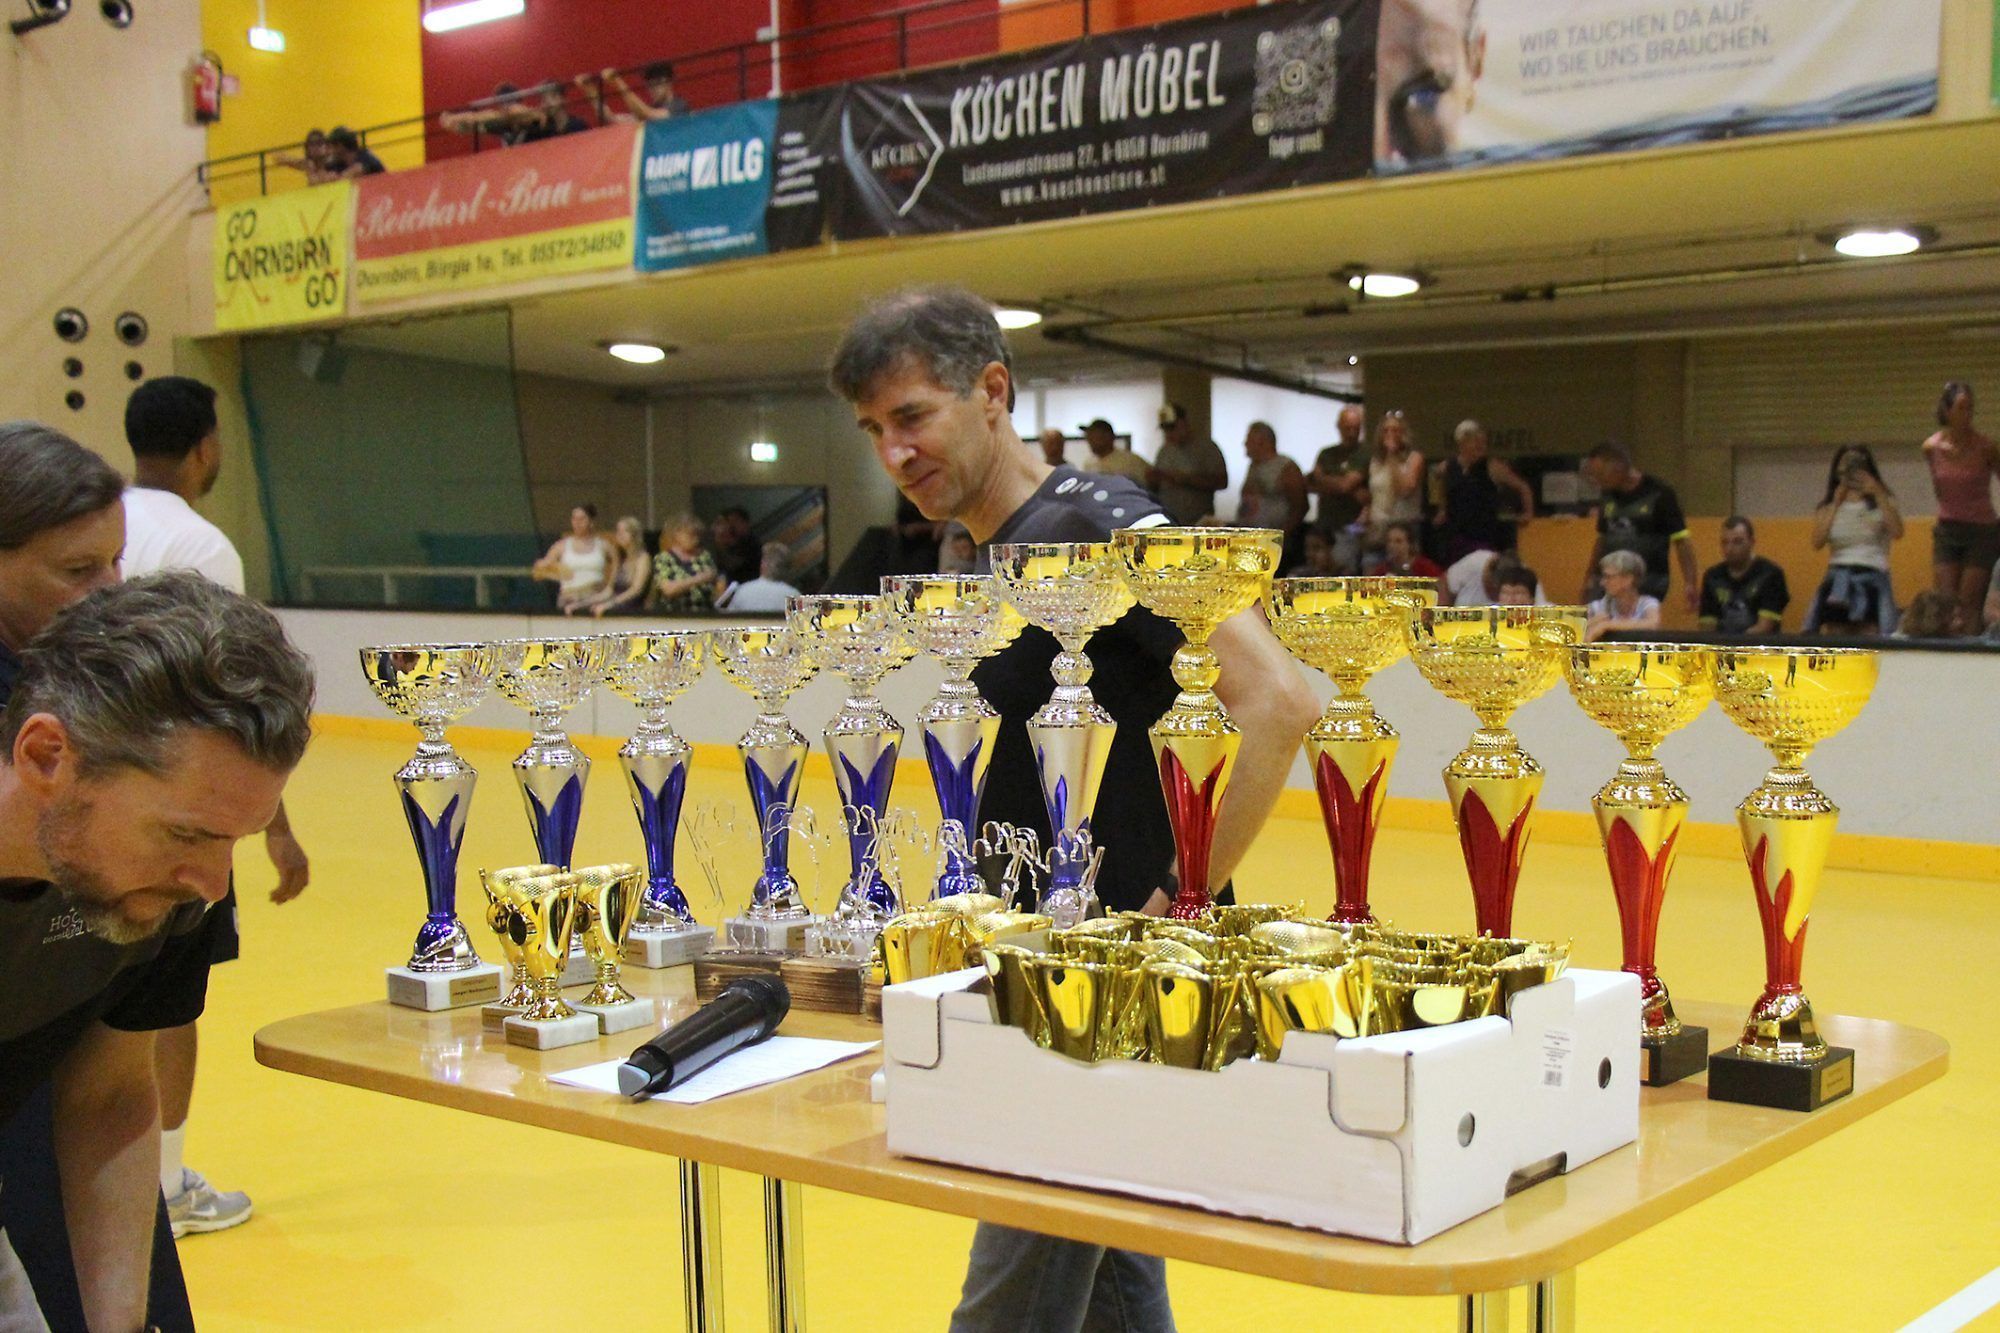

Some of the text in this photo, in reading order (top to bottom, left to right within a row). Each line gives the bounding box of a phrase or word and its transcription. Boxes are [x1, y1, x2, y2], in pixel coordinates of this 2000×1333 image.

[1519, 28, 1559, 54] WIR
[1567, 14, 1667, 48] TAUCHEN
[1673, 6, 1702, 33] DA
[1519, 56, 1550, 79] WO
[1556, 51, 1586, 74] SIE
[1595, 43, 1638, 70] UNS
[949, 39, 1227, 149] KÜCHEN MÖBEL
[720, 137, 765, 186] ILG
[226, 207, 257, 242] GO
[224, 233, 332, 282] DORNBIRN
[305, 271, 338, 308] GO
